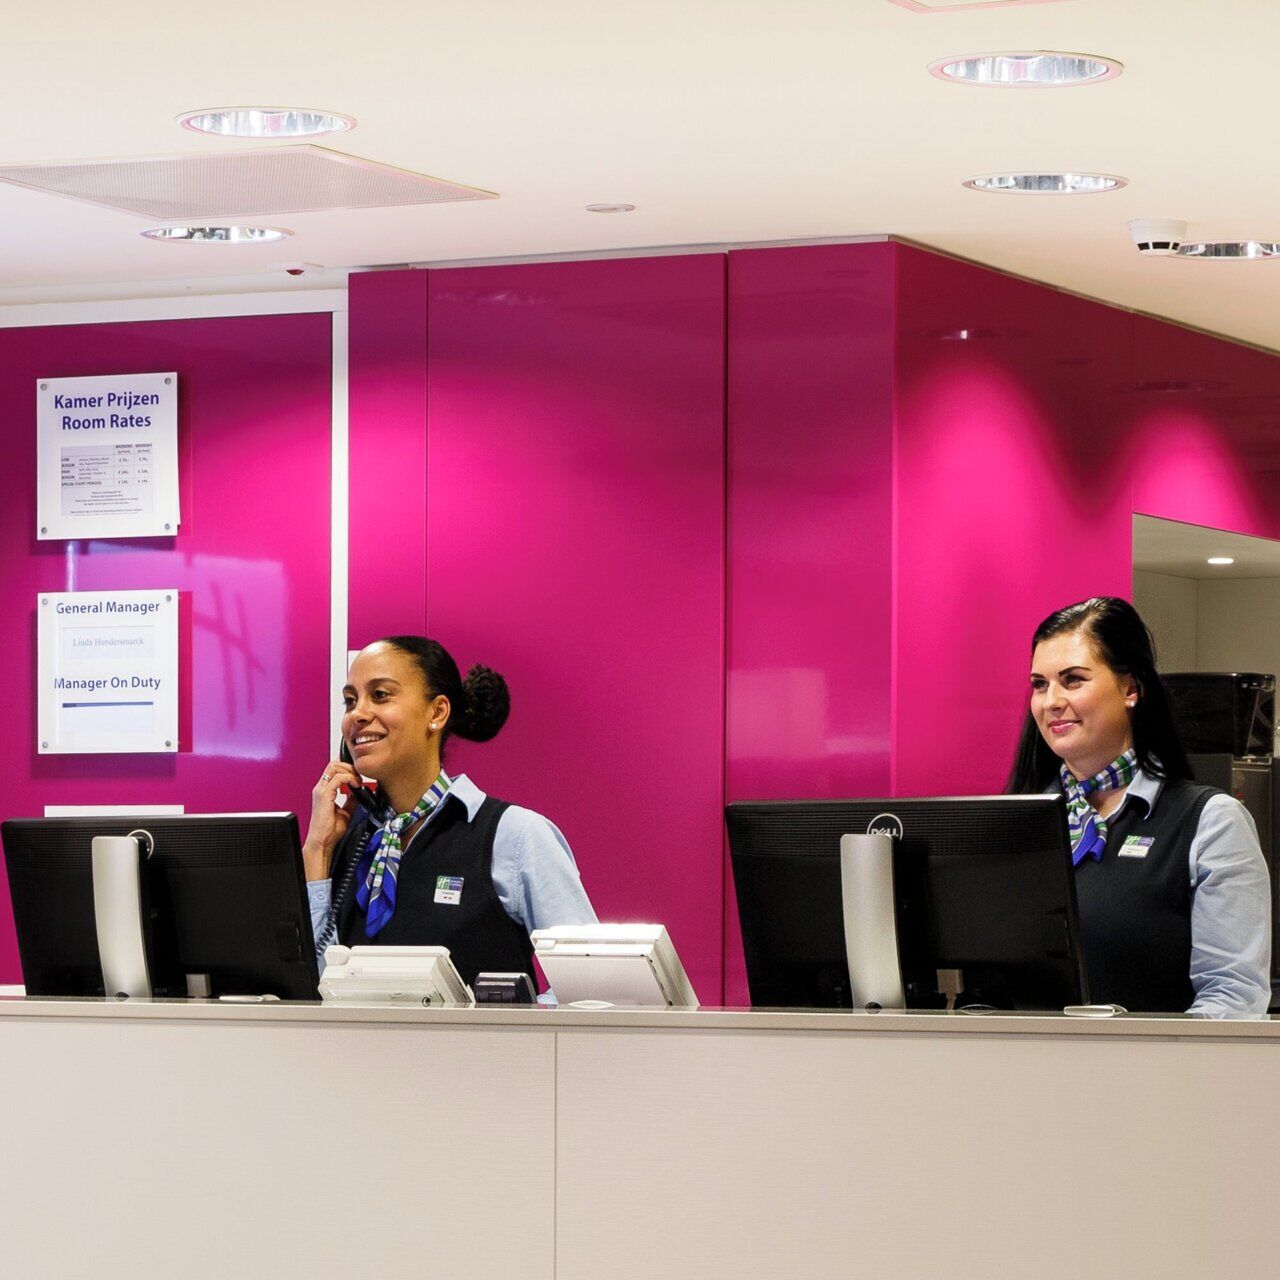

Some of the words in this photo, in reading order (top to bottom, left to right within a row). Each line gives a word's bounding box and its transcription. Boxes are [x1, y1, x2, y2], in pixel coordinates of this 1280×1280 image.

[54, 394, 104, 409] Kamer
[107, 391, 160, 410] Prijzen
[62, 415, 106, 430] Room
[110, 413, 152, 429] Rates
[56, 601, 103, 614] General
[106, 601, 160, 615] Manager
[73, 637, 93, 647] Linda
[54, 677, 107, 691] Manager
[110, 676, 128, 689] On
[131, 676, 161, 690] Duty
